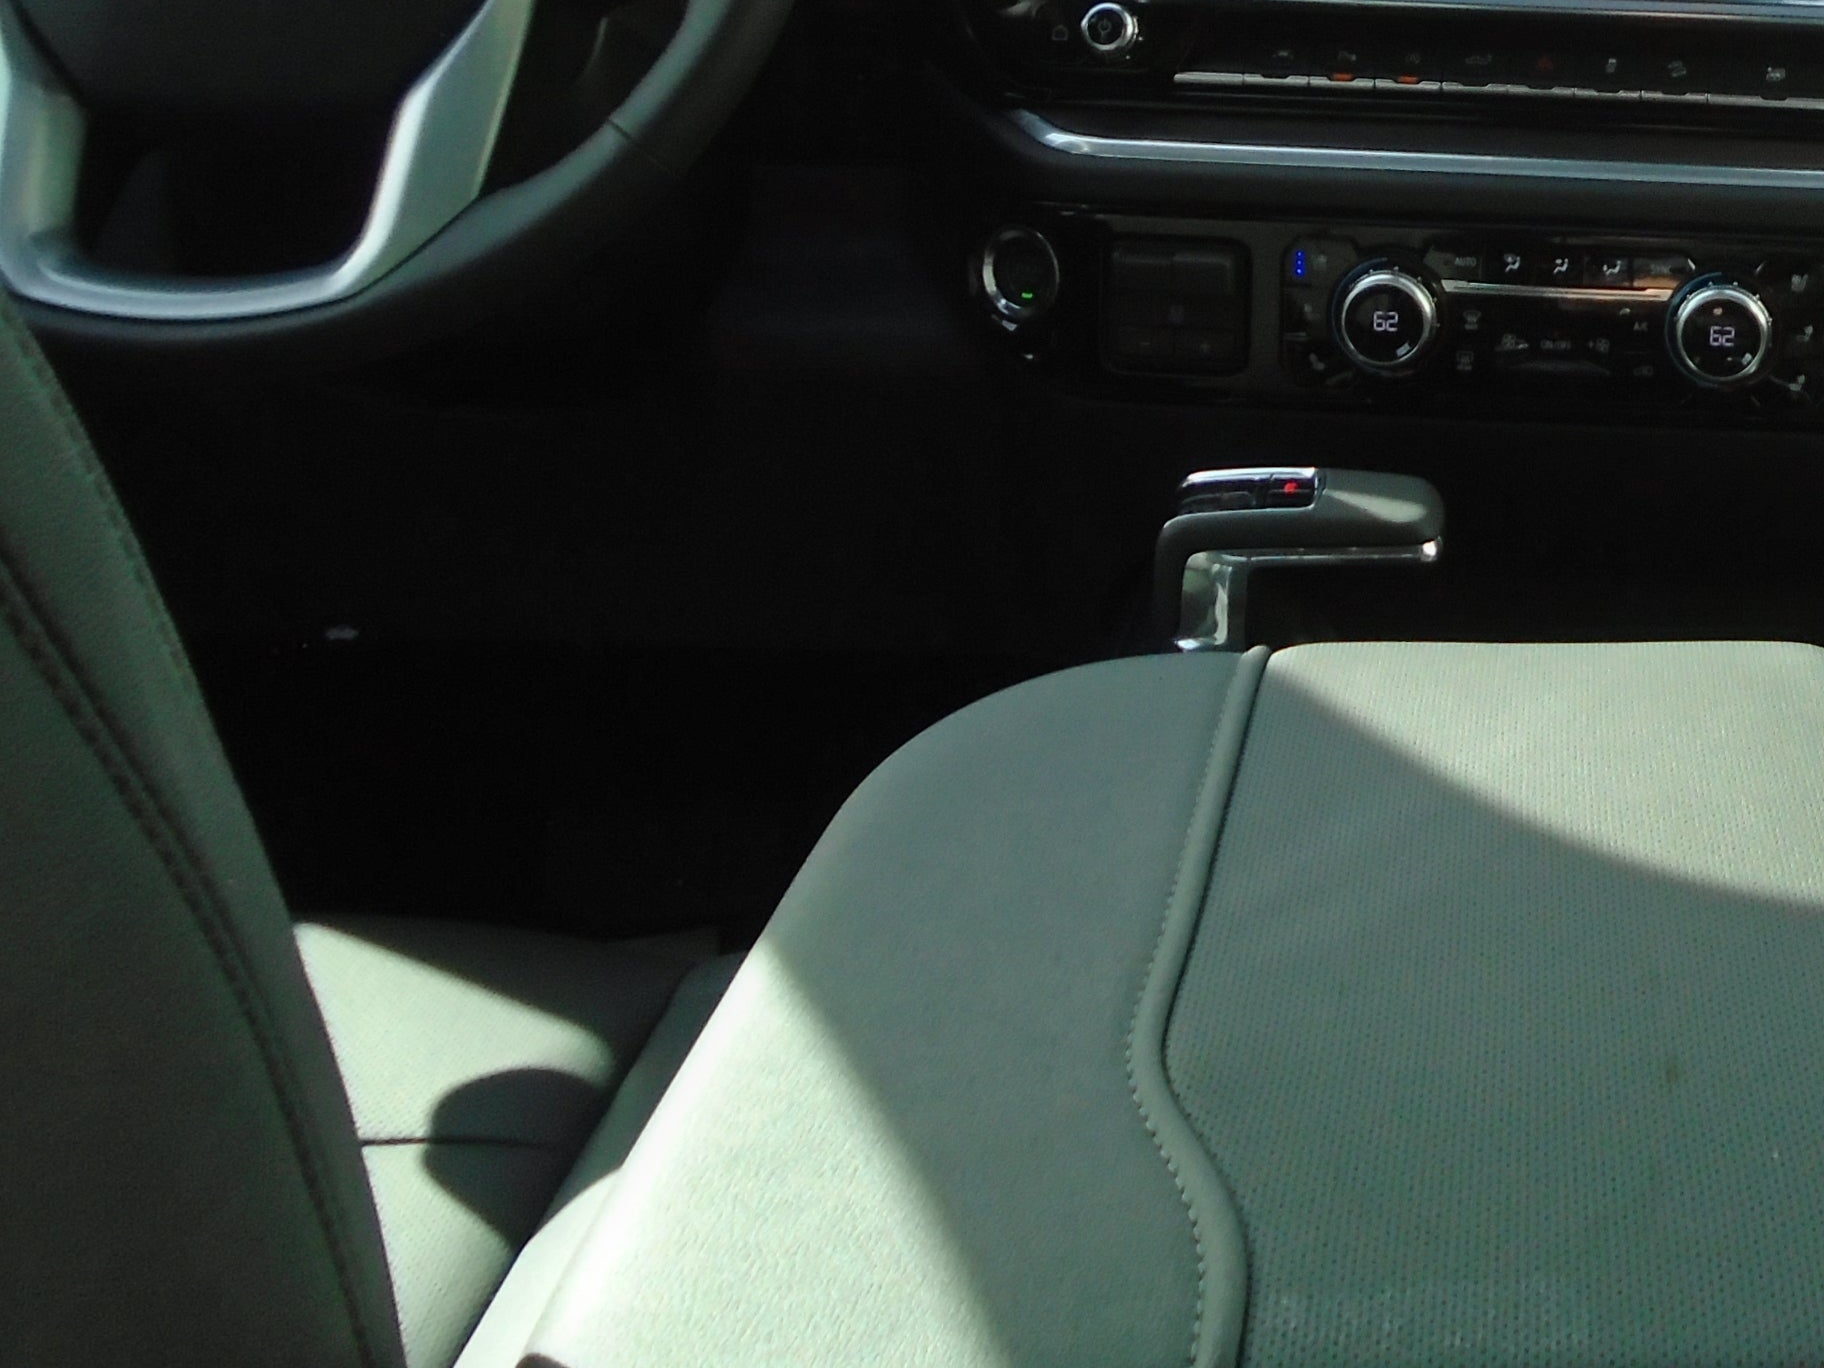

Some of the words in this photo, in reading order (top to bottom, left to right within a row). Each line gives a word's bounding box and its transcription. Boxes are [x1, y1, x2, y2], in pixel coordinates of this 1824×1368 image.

[1453, 256, 1478, 267] AUTO
[1372, 310, 1399, 332] 62
[1708, 325, 1736, 347] 62
